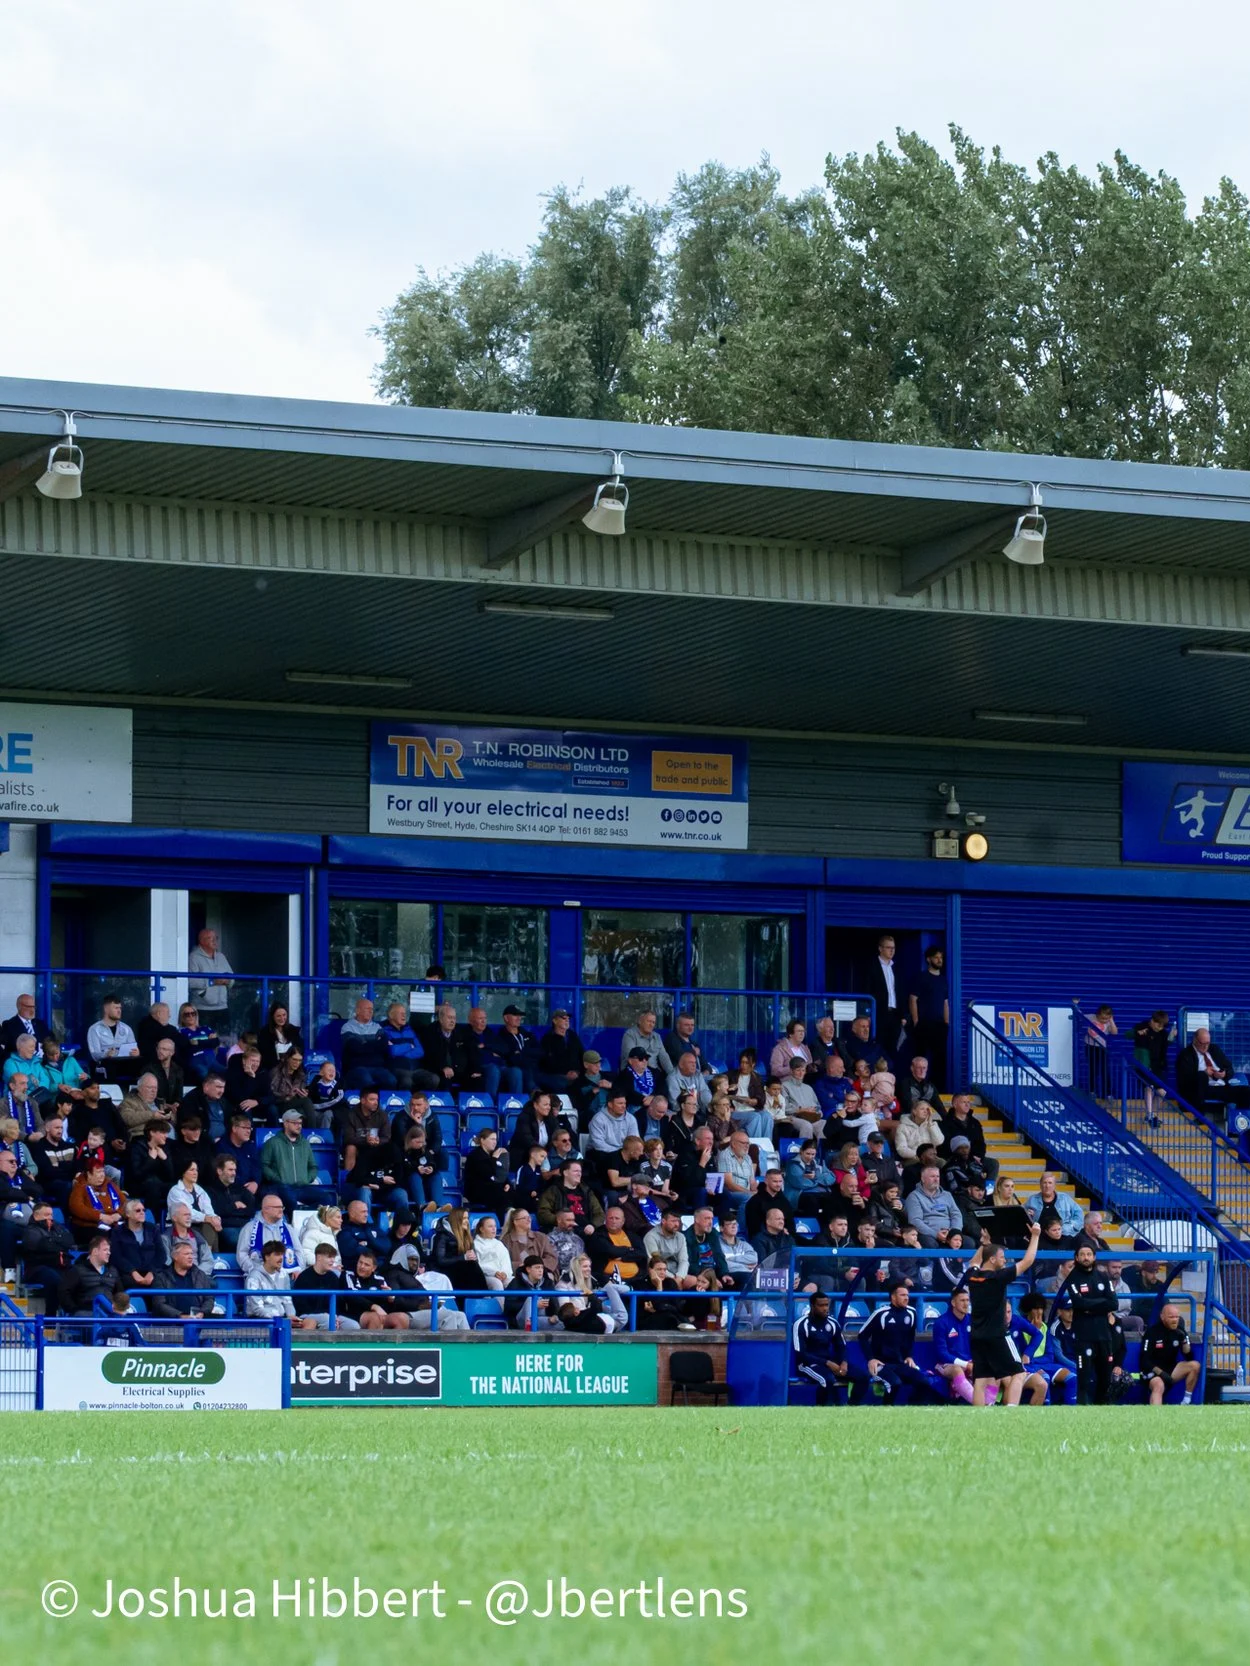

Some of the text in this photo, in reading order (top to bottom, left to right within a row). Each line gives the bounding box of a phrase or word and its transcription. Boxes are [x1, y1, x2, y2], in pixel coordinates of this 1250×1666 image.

[0, 733, 33, 774] E
[388, 735, 465, 780] TNR
[473, 741, 629, 762] T.N. ROBINSON LTD
[473, 758, 524, 769] Wholesale
[573, 763, 629, 775] Distributors
[666, 759, 719, 770] Open to the
[656, 774, 729, 787] trade and public
[1218, 770, 1250, 780] Welcome
[387, 795, 629, 821] For all your electrical needs!
[387, 818, 424, 829] Westbury
[426, 820, 452, 830] Street,
[454, 821, 477, 831] Hyde,
[479, 822, 514, 832] Cheshire
[516, 824, 537, 832] SK14
[538, 825, 556, 833] 4QP
[573, 826, 591, 834] 0161
[609, 828, 629, 837] 9453
[660, 831, 722, 841] www.tnr.co.uk
[1202, 851, 1224, 860] Proud
[998, 1011, 1044, 1038] TNR
[760, 1278, 785, 1287] HOME
[121, 1358, 206, 1378] Pinnacle
[516, 1355, 583, 1372] HERE FOR
[122, 1387, 205, 1399] Electrical Supplies
[470, 1376, 629, 1394] THE NATIONAL LEAGUE
[89, 1402, 184, 1410] www.pinnacle-bolton.co.uk
